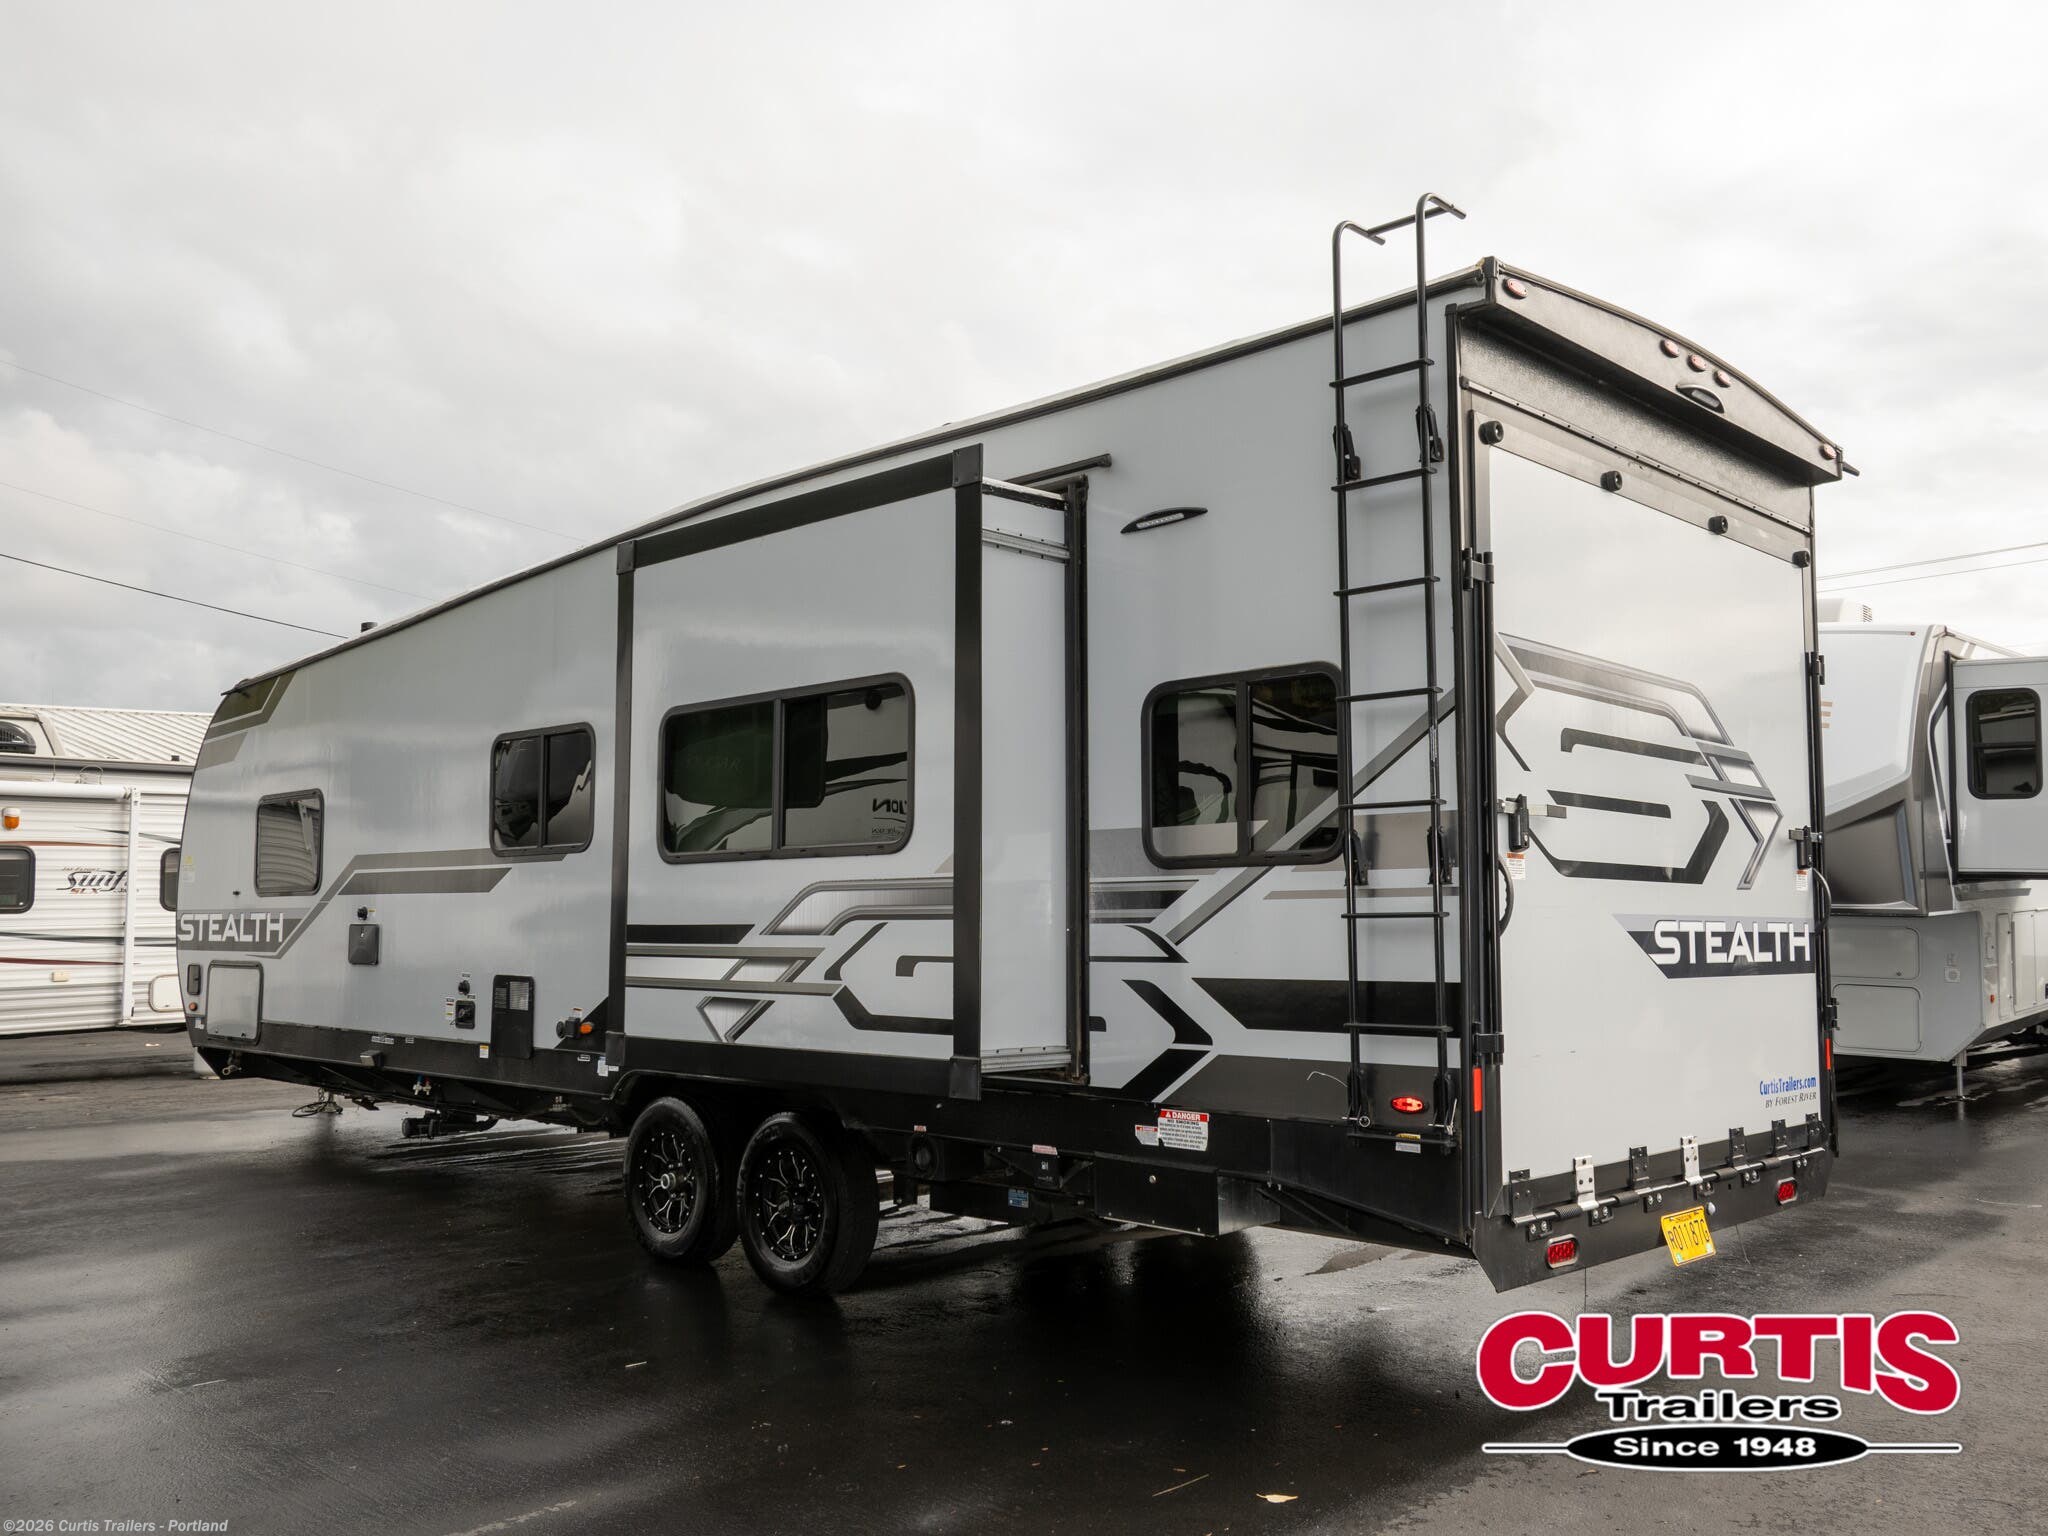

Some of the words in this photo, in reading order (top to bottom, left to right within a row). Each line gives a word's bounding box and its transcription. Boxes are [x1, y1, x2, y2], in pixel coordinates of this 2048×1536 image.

[177, 912, 284, 943] STEALTH
[1648, 920, 1811, 965] STEALTH
[1759, 1076, 1817, 1095] CurtisTrailers.com
[1775, 1094, 1798, 1107] FOREST
[1172, 1111, 1201, 1121] DANGER
